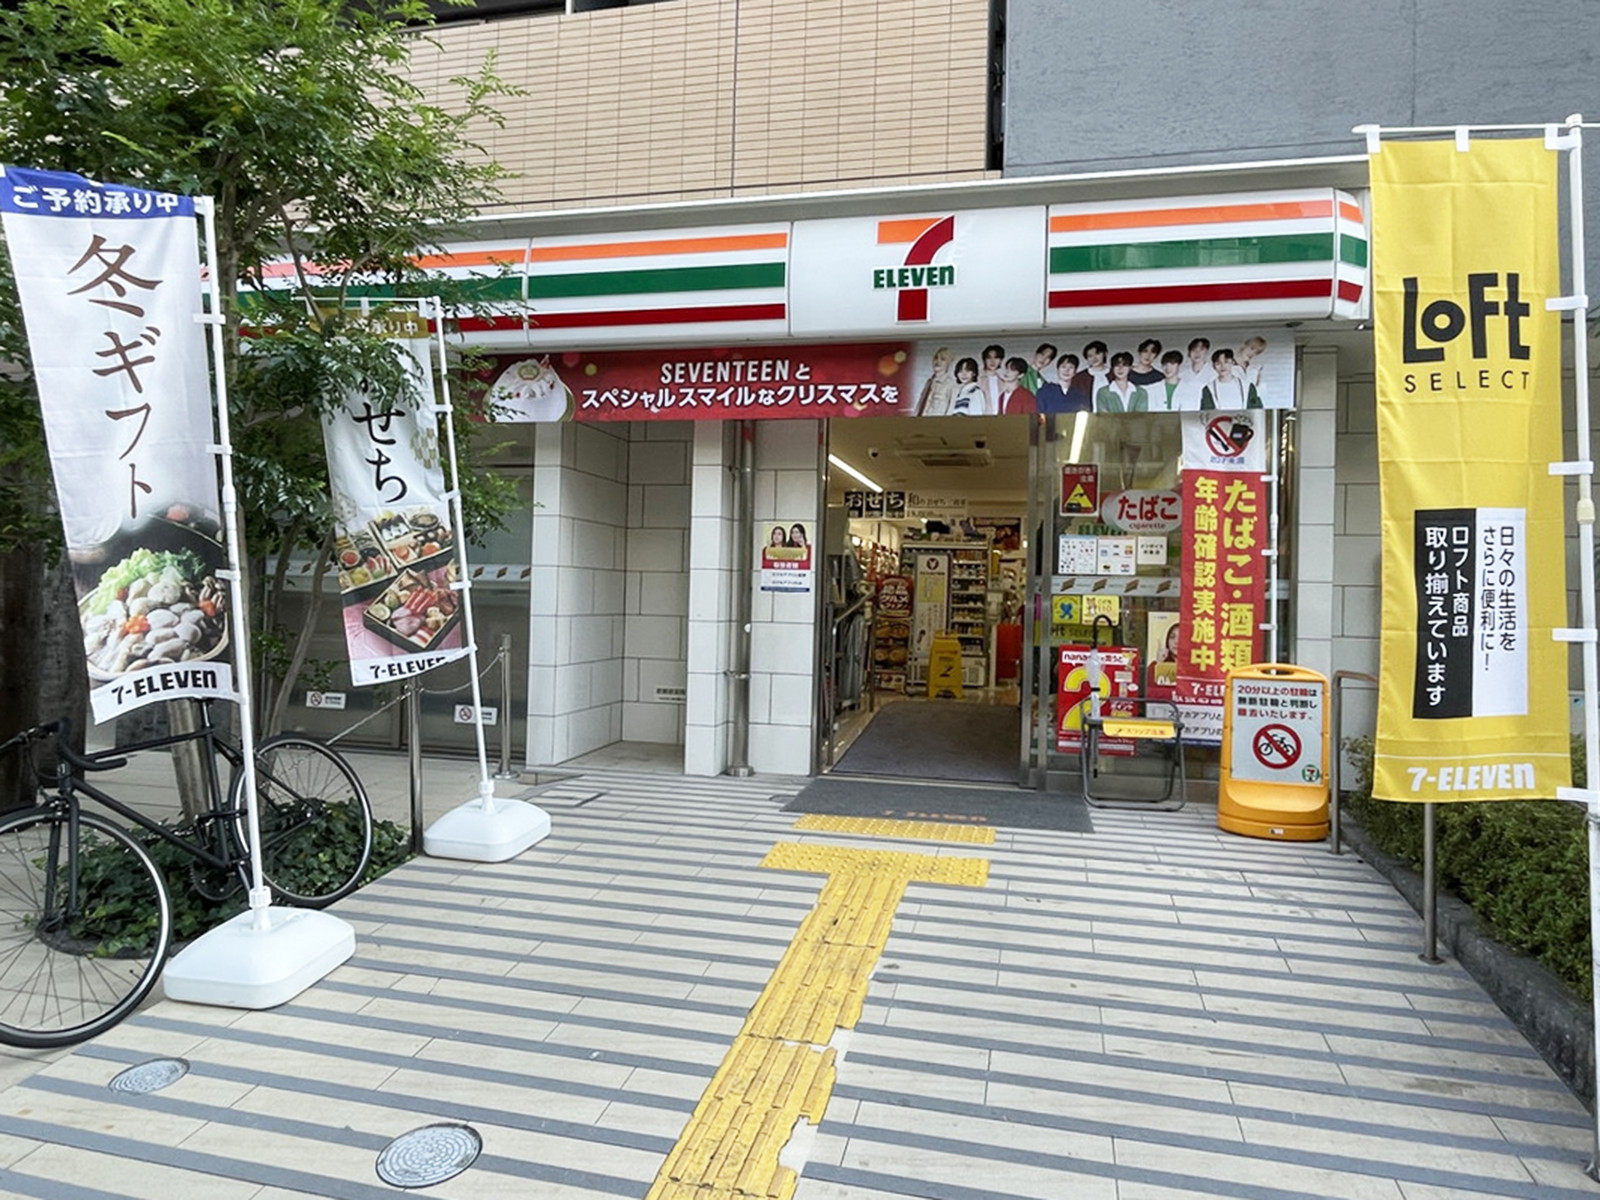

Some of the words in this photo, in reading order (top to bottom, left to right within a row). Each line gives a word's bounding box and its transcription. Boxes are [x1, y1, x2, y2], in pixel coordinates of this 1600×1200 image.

[12, 184, 179, 215] ご予約承り中
[67, 233, 163, 519] 冬ギフト
[581, 383, 899, 410] スペシャルスマイルなクリスマスを
[1404, 370, 1530, 393] SELECT
[846, 493, 904, 508] おせち
[1117, 496, 1178, 521] たばこ
[1190, 476, 1219, 672] 年齢確認実施中
[1220, 479, 1257, 673] たばこ・酒類
[1451, 526, 1470, 638] ロフト商品
[1499, 526, 1517, 652] 日々の生活を
[1424, 526, 1449, 706] 取り揃えています
[1238, 685, 1317, 697] 20分以上の駐輪は
